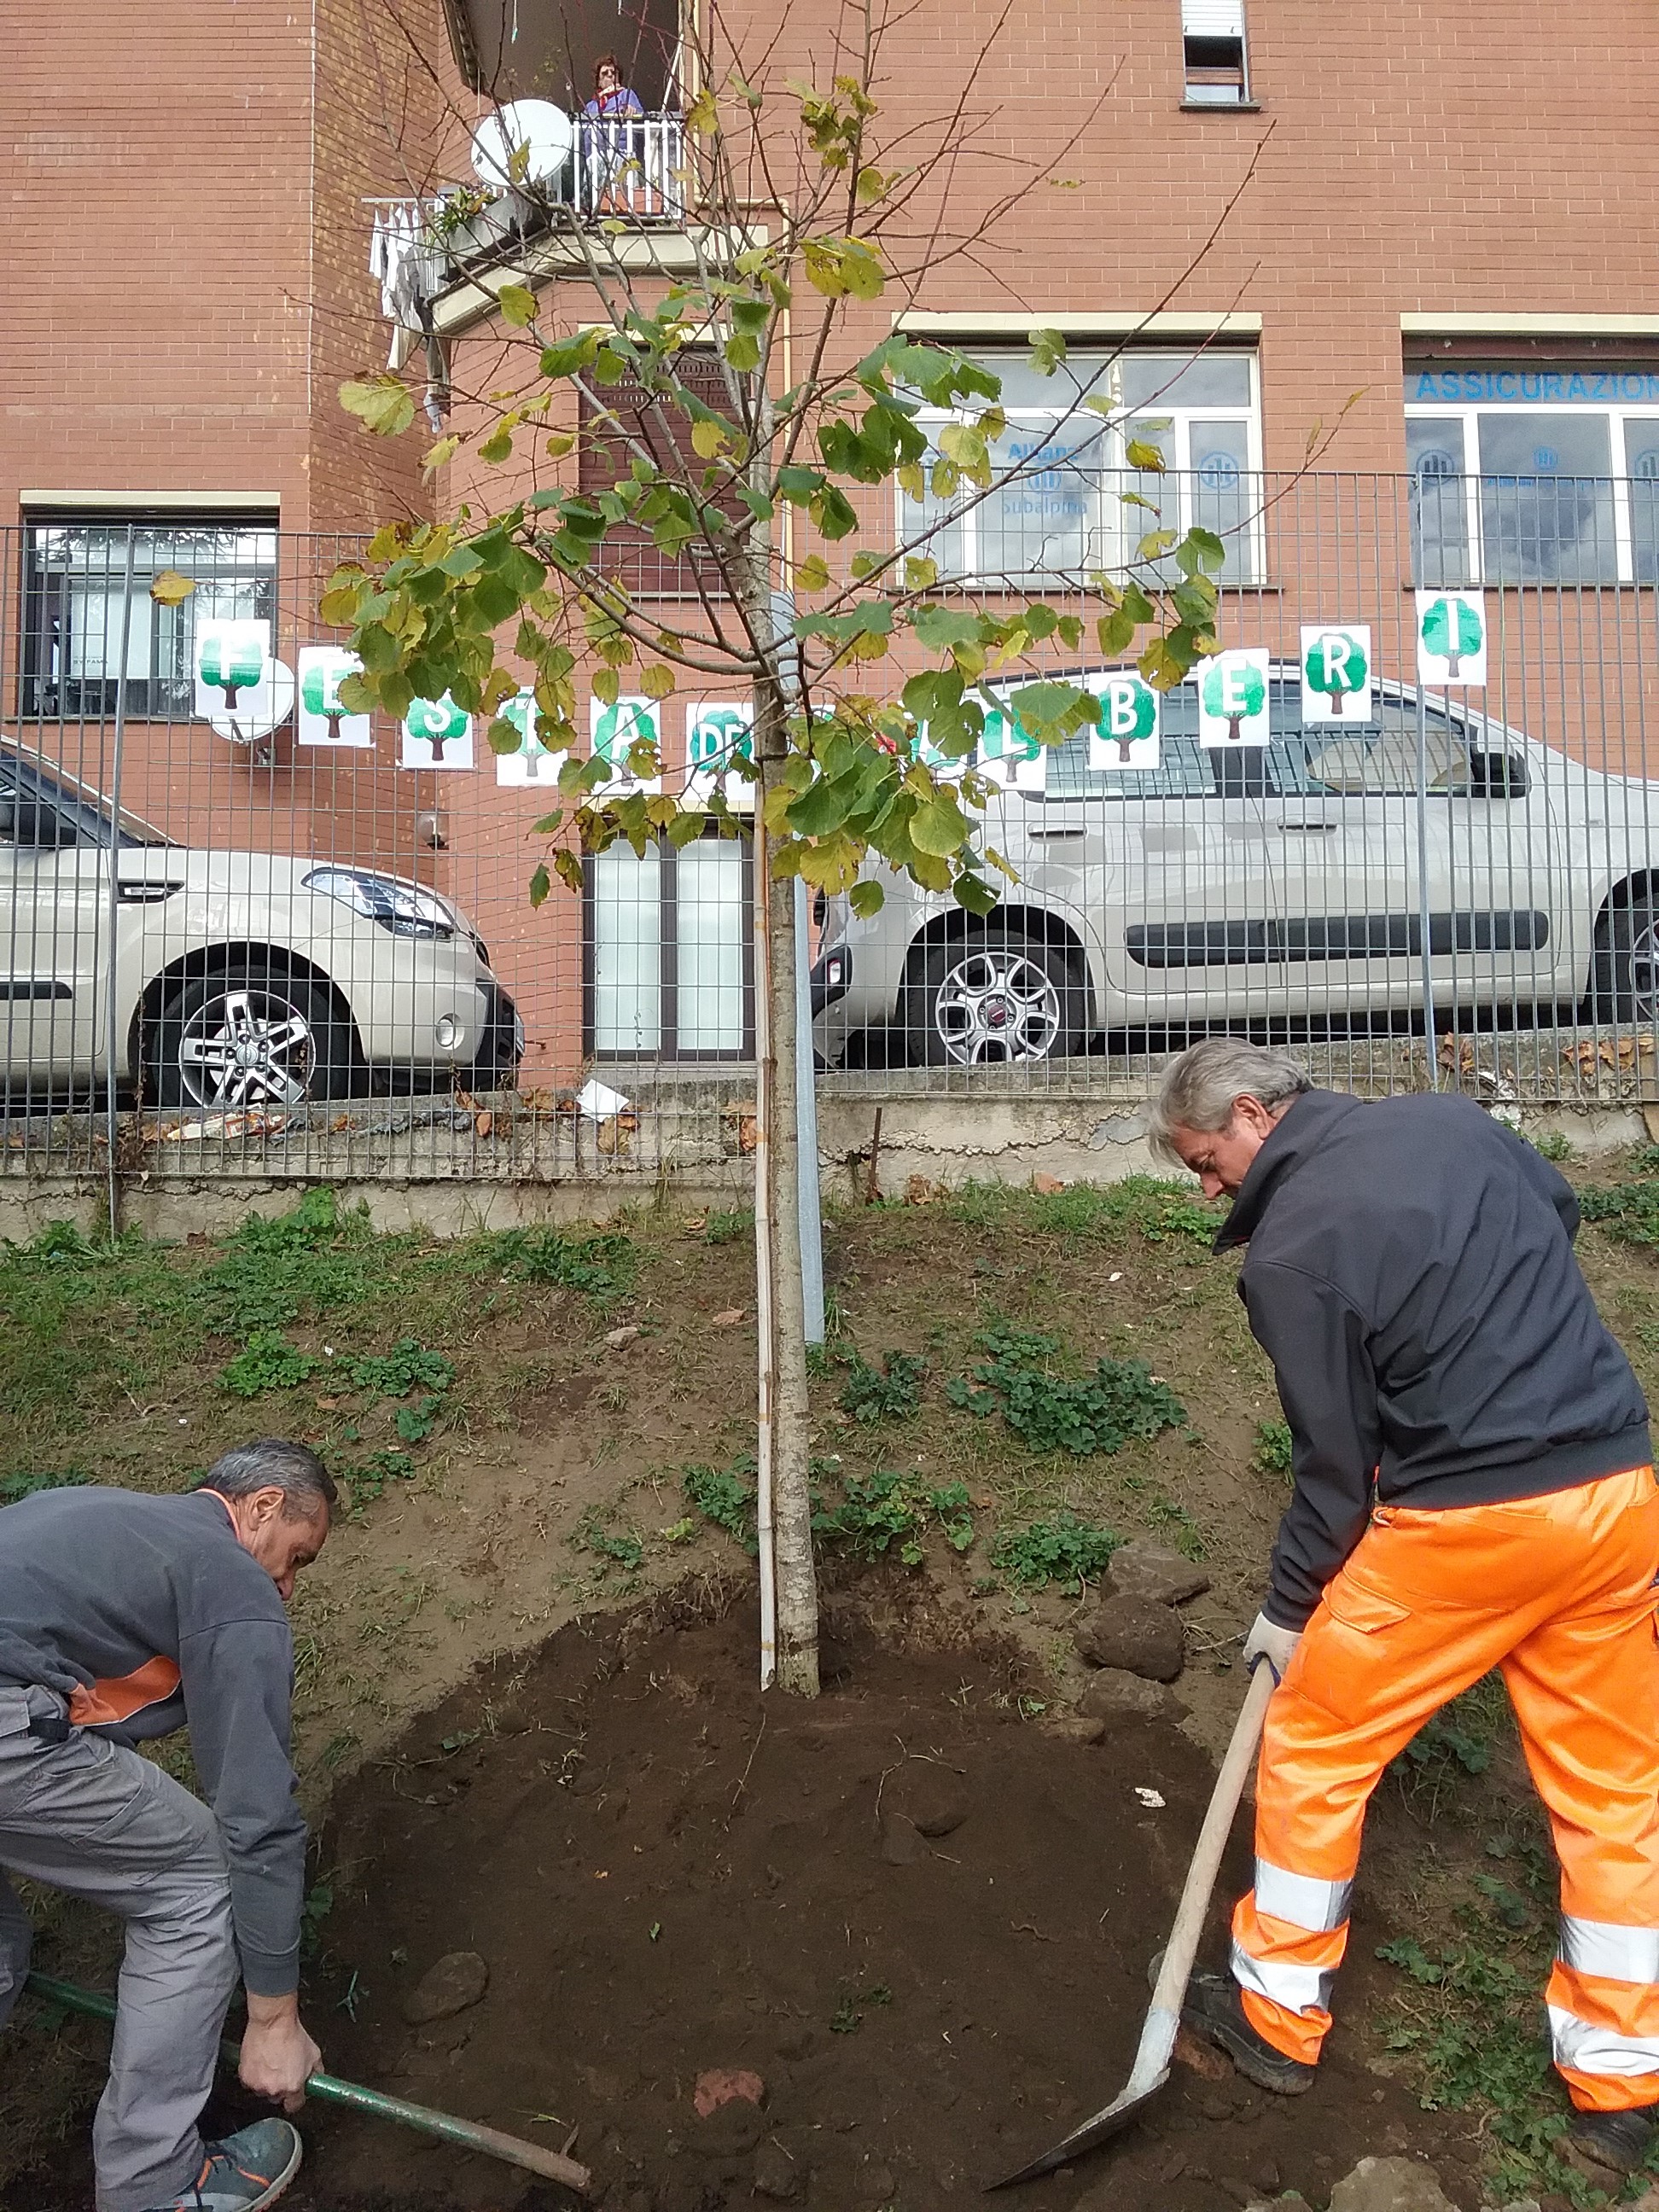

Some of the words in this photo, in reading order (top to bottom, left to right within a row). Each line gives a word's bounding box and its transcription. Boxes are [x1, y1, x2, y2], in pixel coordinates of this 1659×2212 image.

[1110, 681, 1138, 735] B
[1221, 657, 1247, 711] E
[1321, 634, 1352, 687] R
